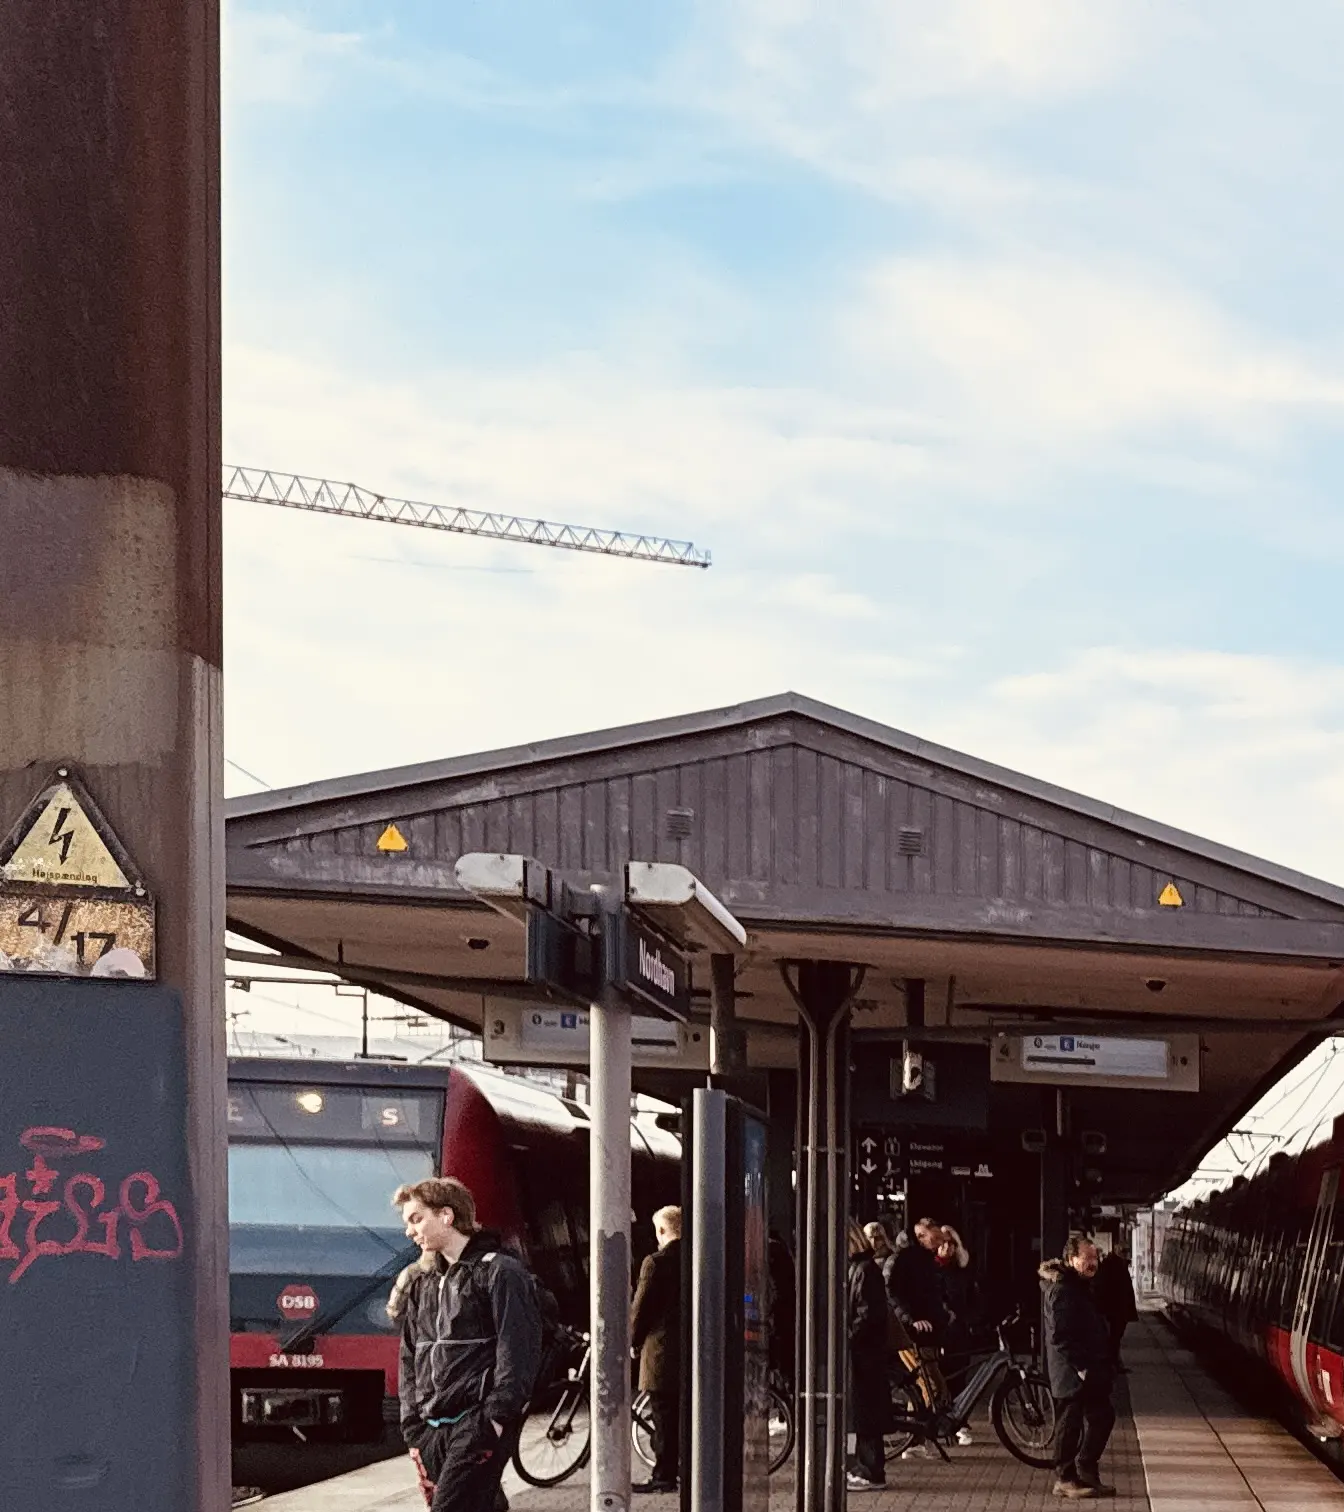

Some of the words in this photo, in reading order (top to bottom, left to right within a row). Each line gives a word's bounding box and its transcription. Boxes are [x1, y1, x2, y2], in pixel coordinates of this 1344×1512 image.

[638, 937, 676, 997] Nordhavn
[381, 1107, 399, 1126] S
[281, 1295, 315, 1310] DSB
[269, 1353, 290, 1368] SA
